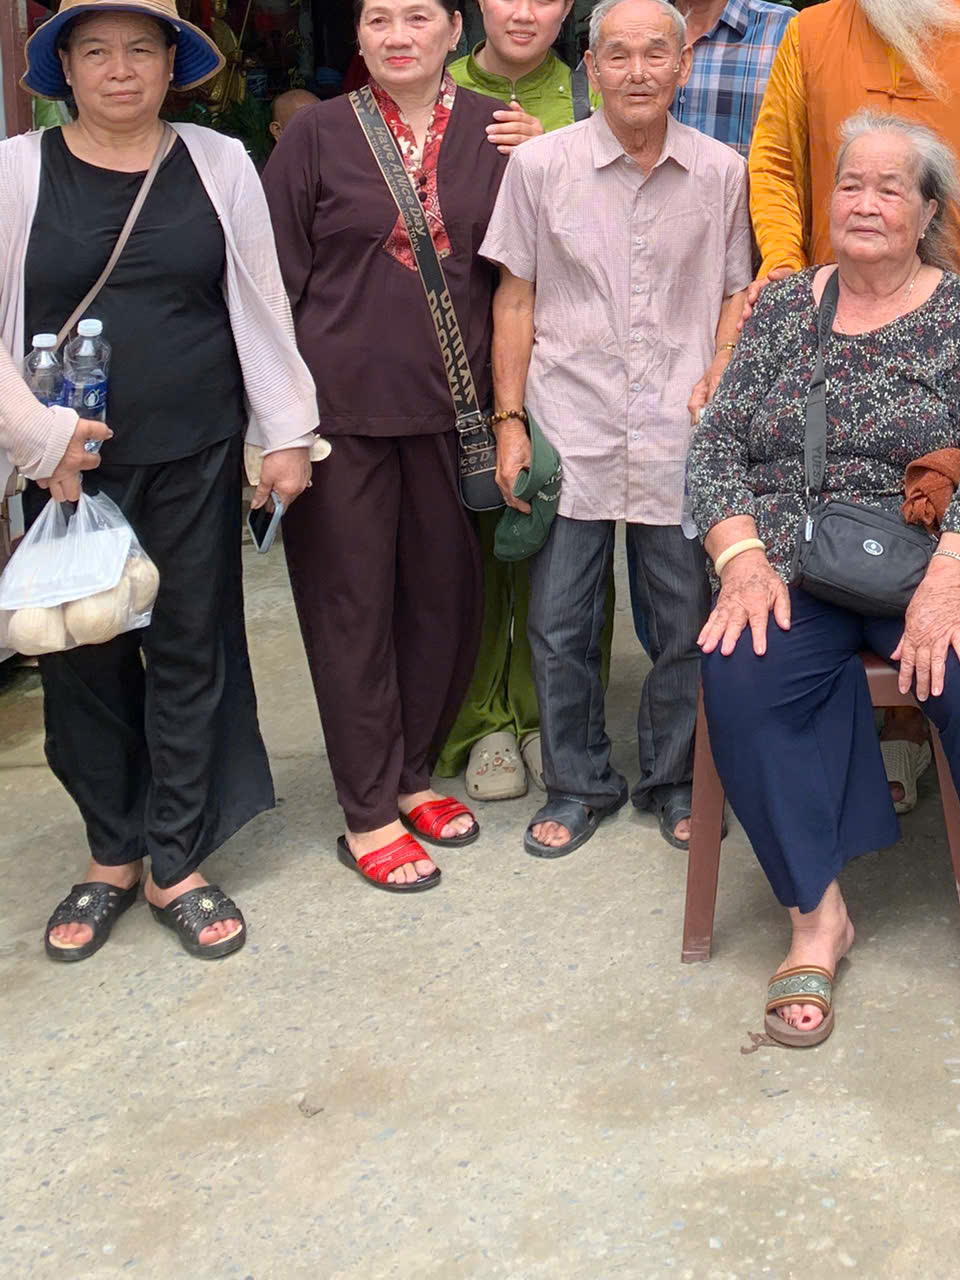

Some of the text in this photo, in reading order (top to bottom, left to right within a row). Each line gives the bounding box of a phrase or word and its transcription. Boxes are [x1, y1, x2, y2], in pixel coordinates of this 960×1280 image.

[374, 126, 396, 161] Have
[395, 173, 415, 205] Nice
[409, 207, 427, 236] Day
